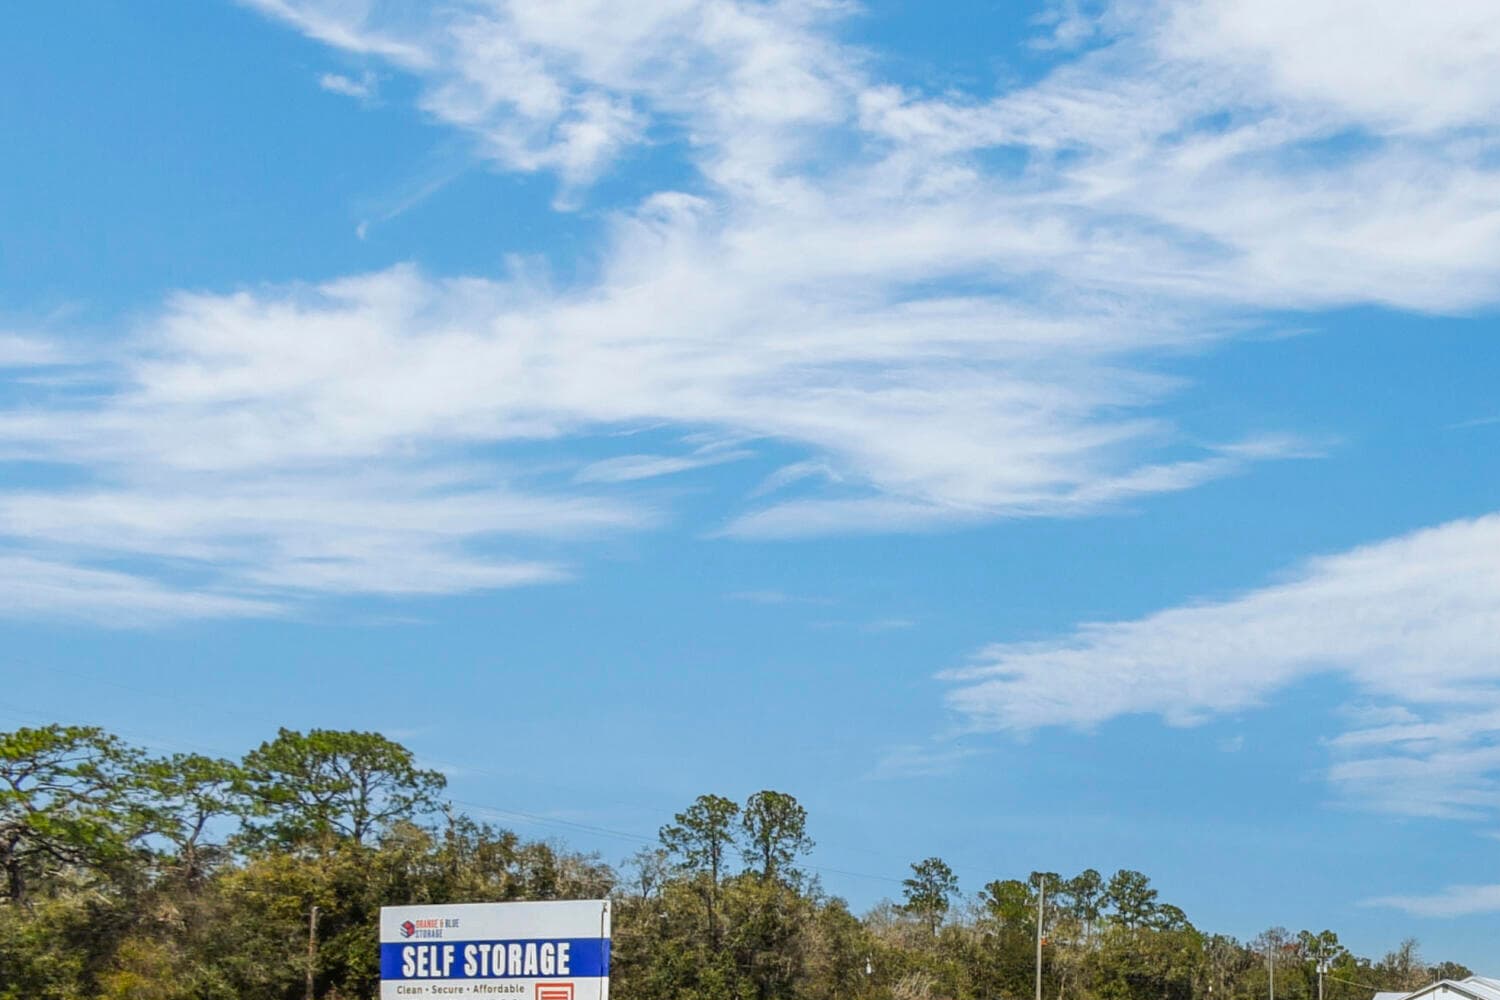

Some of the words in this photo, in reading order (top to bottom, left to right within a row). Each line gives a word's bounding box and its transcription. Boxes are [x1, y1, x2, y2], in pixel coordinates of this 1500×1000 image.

[416, 919, 437, 928] ORANGE
[445, 919, 459, 928] BLUE
[415, 929, 443, 938] STORAGE
[402, 945, 455, 978] SELF
[464, 942, 570, 977] STORAGE
[397, 985, 423, 995] Clean
[431, 985, 464, 994] Secure
[473, 984, 525, 994] Affordable
